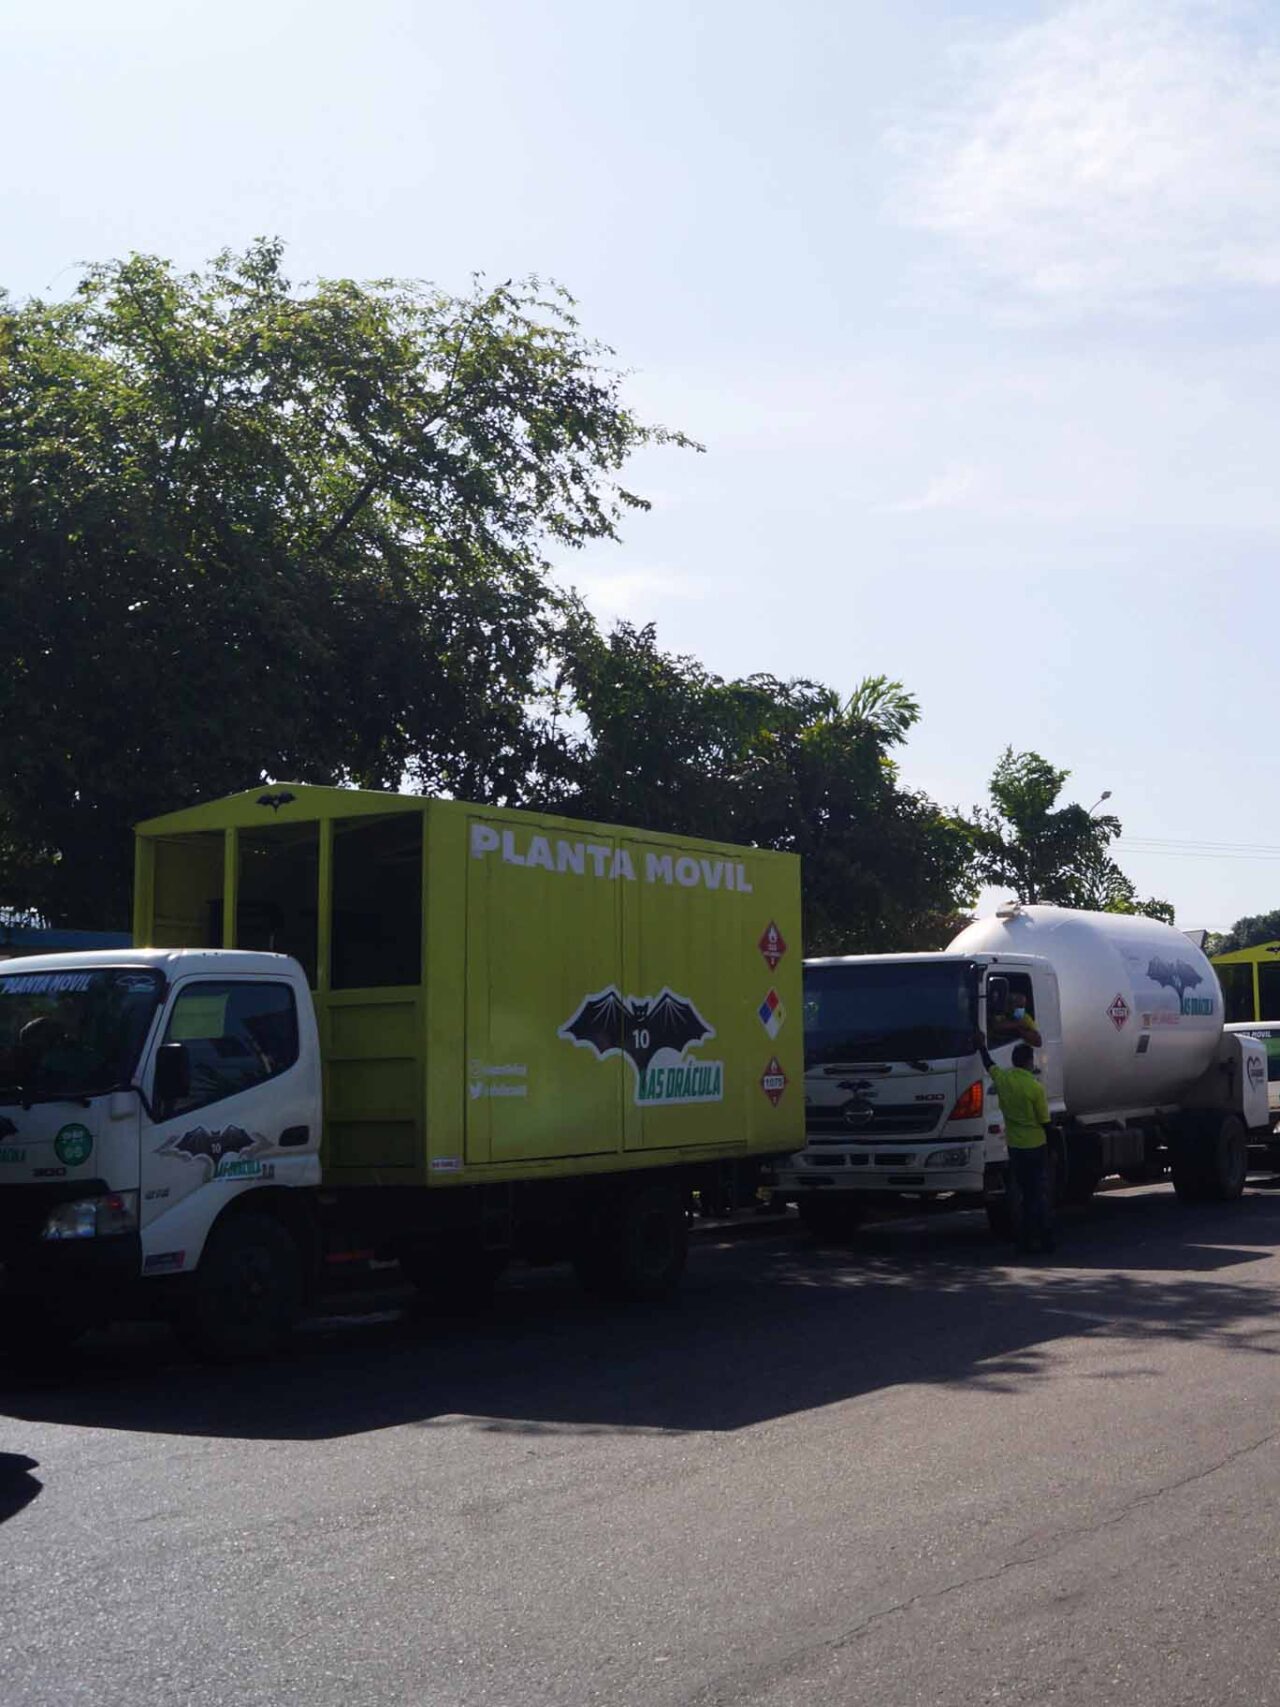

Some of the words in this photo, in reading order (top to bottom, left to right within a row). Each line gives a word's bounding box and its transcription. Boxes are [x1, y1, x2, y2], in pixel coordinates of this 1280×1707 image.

[470, 825, 637, 881] PLANTA
[645, 853, 753, 894] MOVIL
[48, 974, 92, 992] MOVIL
[632, 1029, 650, 1048] 10
[666, 1060, 720, 1097] DRÁCULA
[210, 1142, 222, 1154] 10
